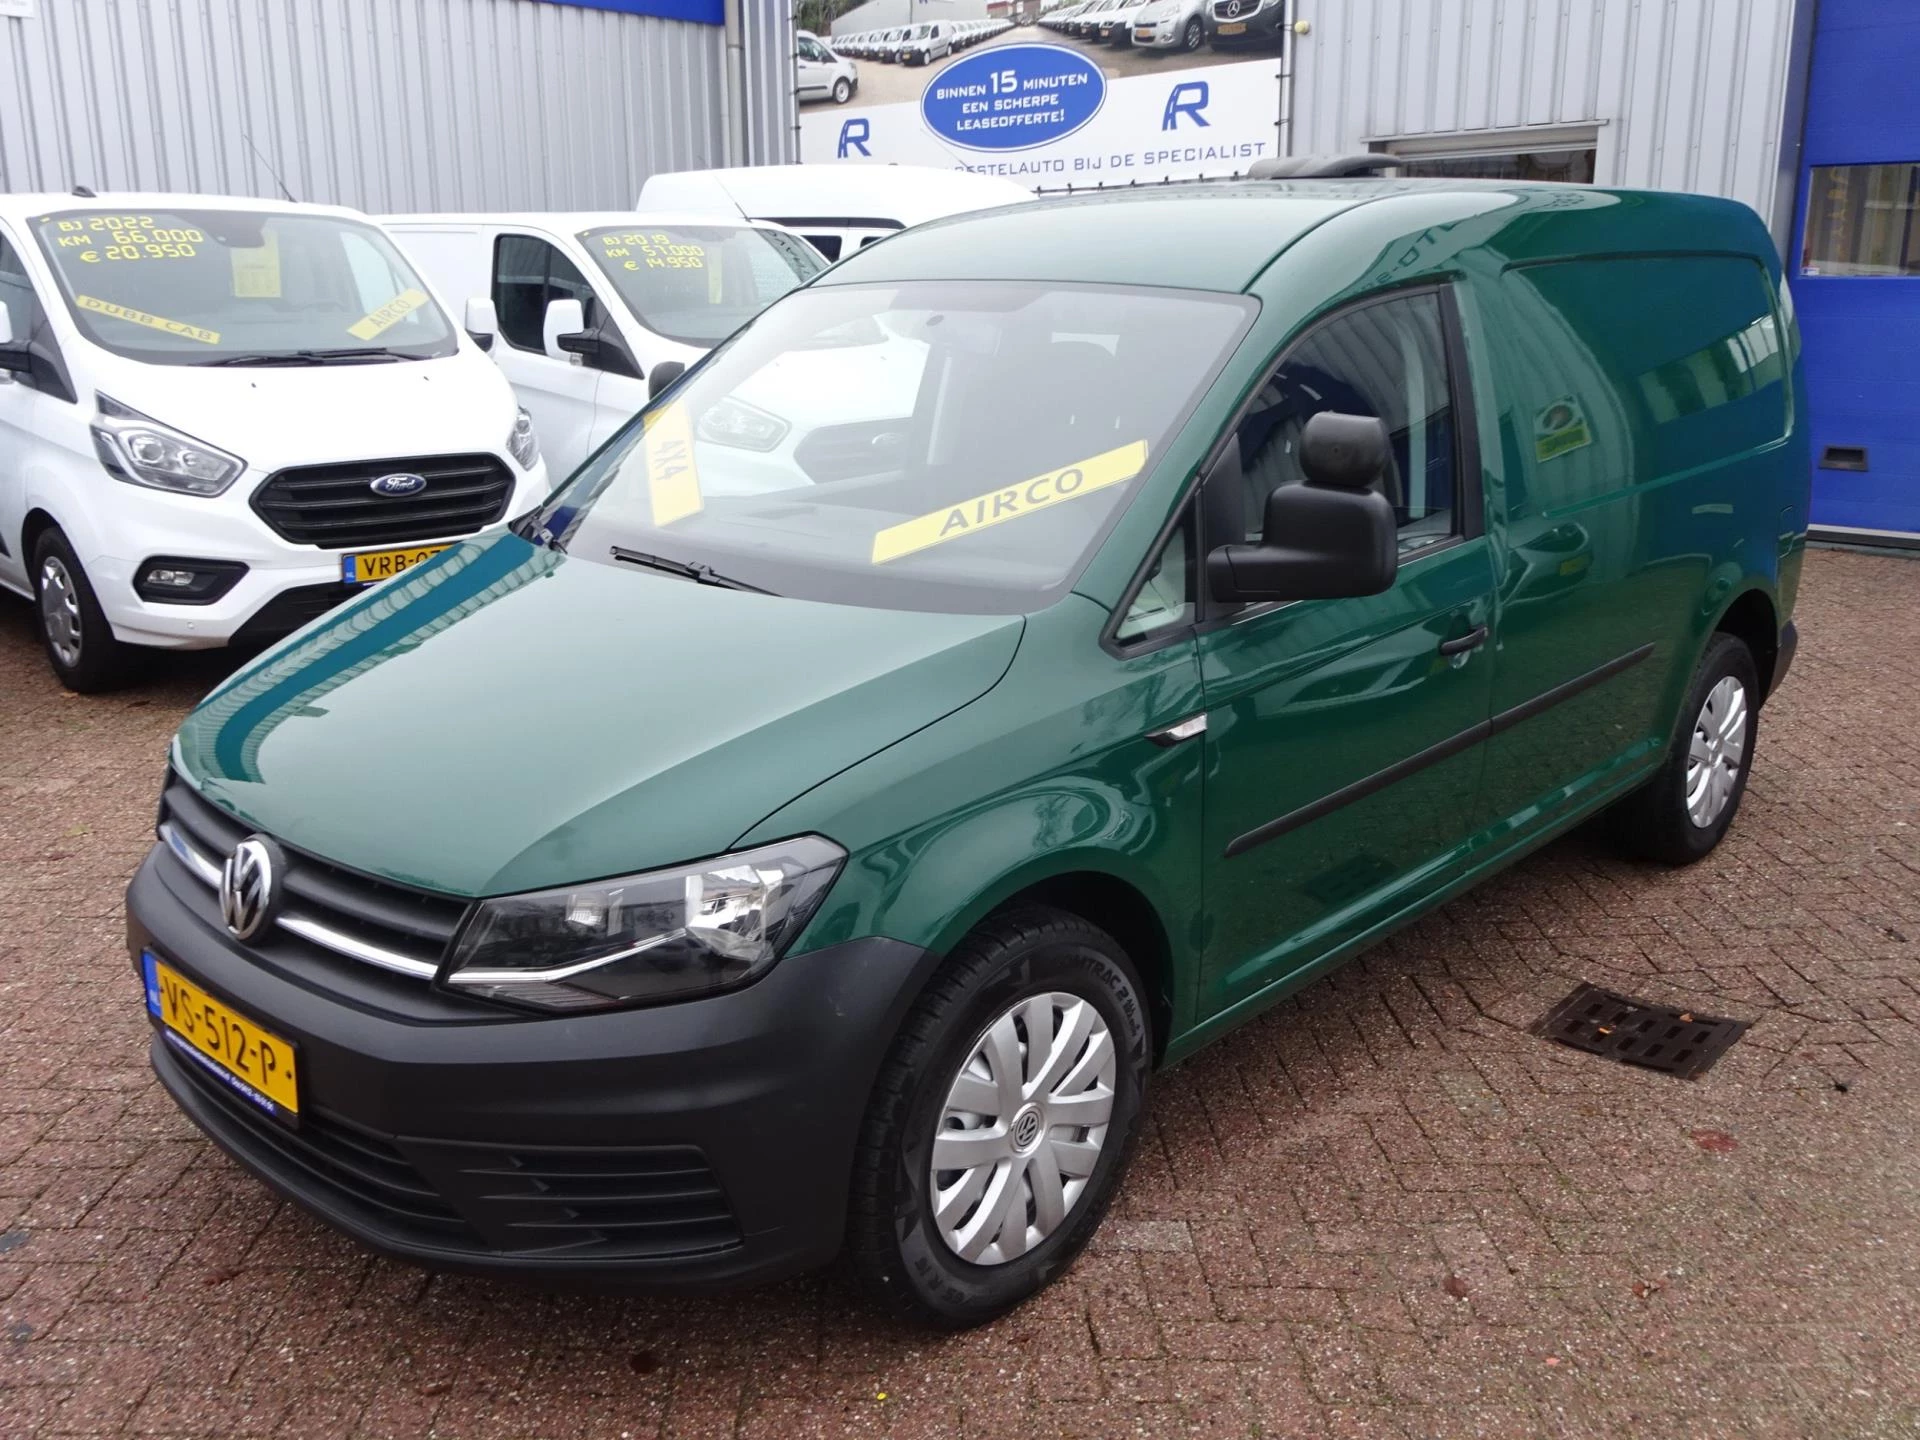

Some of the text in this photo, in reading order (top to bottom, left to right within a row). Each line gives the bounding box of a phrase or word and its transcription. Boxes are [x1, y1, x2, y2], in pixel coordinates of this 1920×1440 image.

[936, 70, 1088, 100] BINNEN 15 MINUTEN
[962, 93, 1060, 114] EEN SCHERPE
[956, 108, 1065, 131] LEASEOFFERTE!
[1073, 157, 1102, 170] BIJ
[1110, 153, 1135, 168] DE
[1143, 142, 1267, 165] SPECIALIST
[58, 215, 155, 232] BJ 2022
[57, 228, 204, 248] KM 66.000
[80, 243, 196, 263] € 20.950
[605, 247, 630, 258] KM
[646, 256, 704, 269] 14.950
[165, 321, 212, 341] CAB
[384, 476, 417, 491] Ford
[939, 468, 1084, 537] AIRCO
[363, 549, 441, 576] VRB-
[163, 975, 277, 1086] VS-512-P
